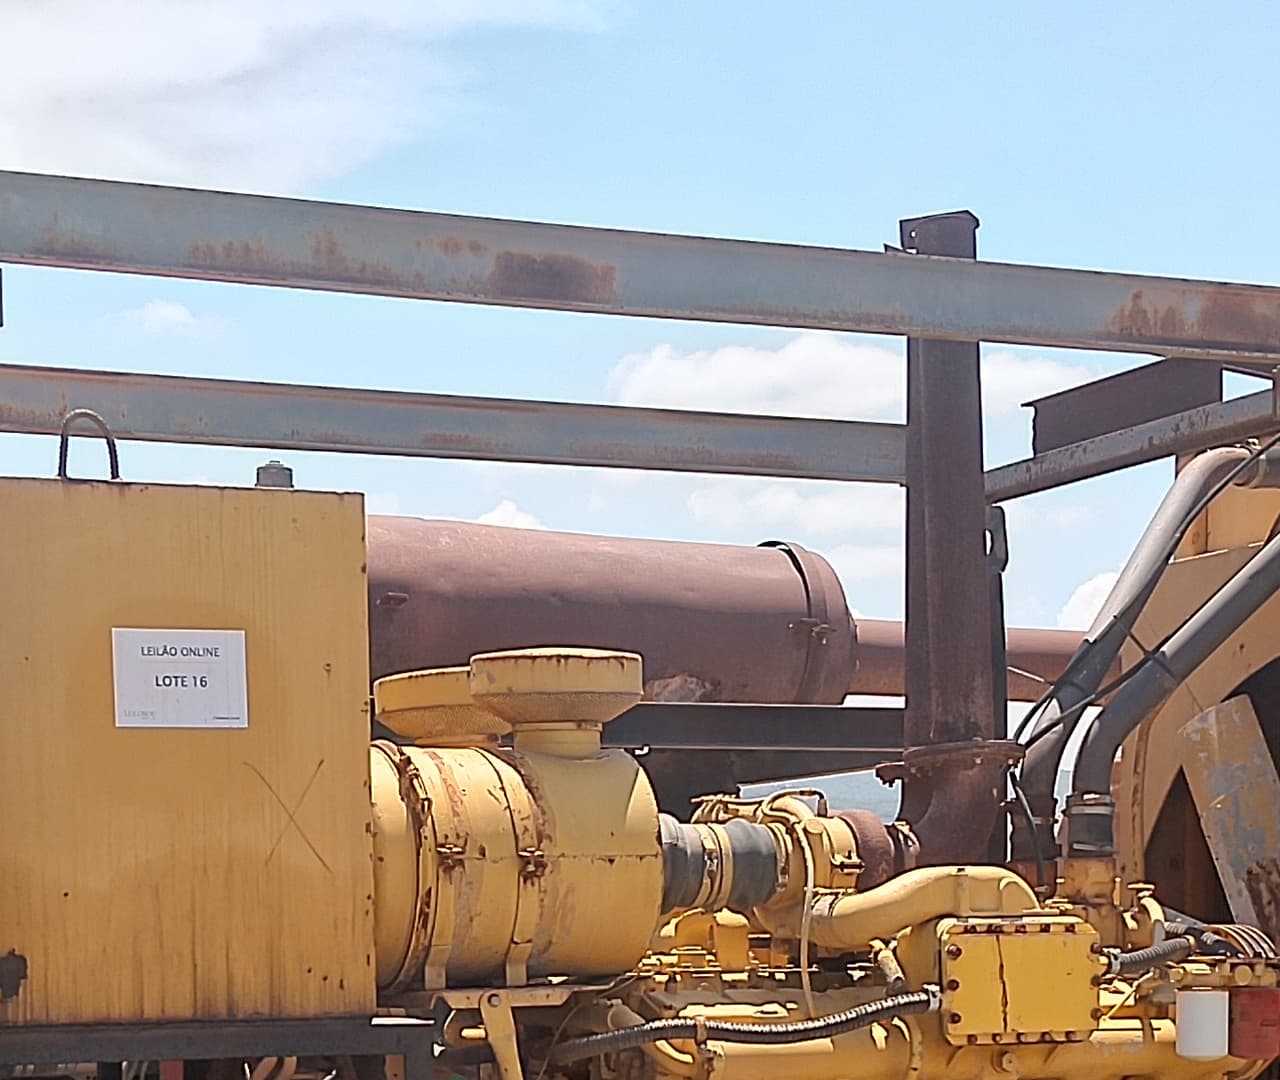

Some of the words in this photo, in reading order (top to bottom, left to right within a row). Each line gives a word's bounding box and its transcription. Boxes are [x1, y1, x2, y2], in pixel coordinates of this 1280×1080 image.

[141, 644, 178, 657] LEILÃO
[180, 647, 220, 657] ONLINE
[155, 675, 188, 687] LOTE
[193, 675, 208, 688] 16
